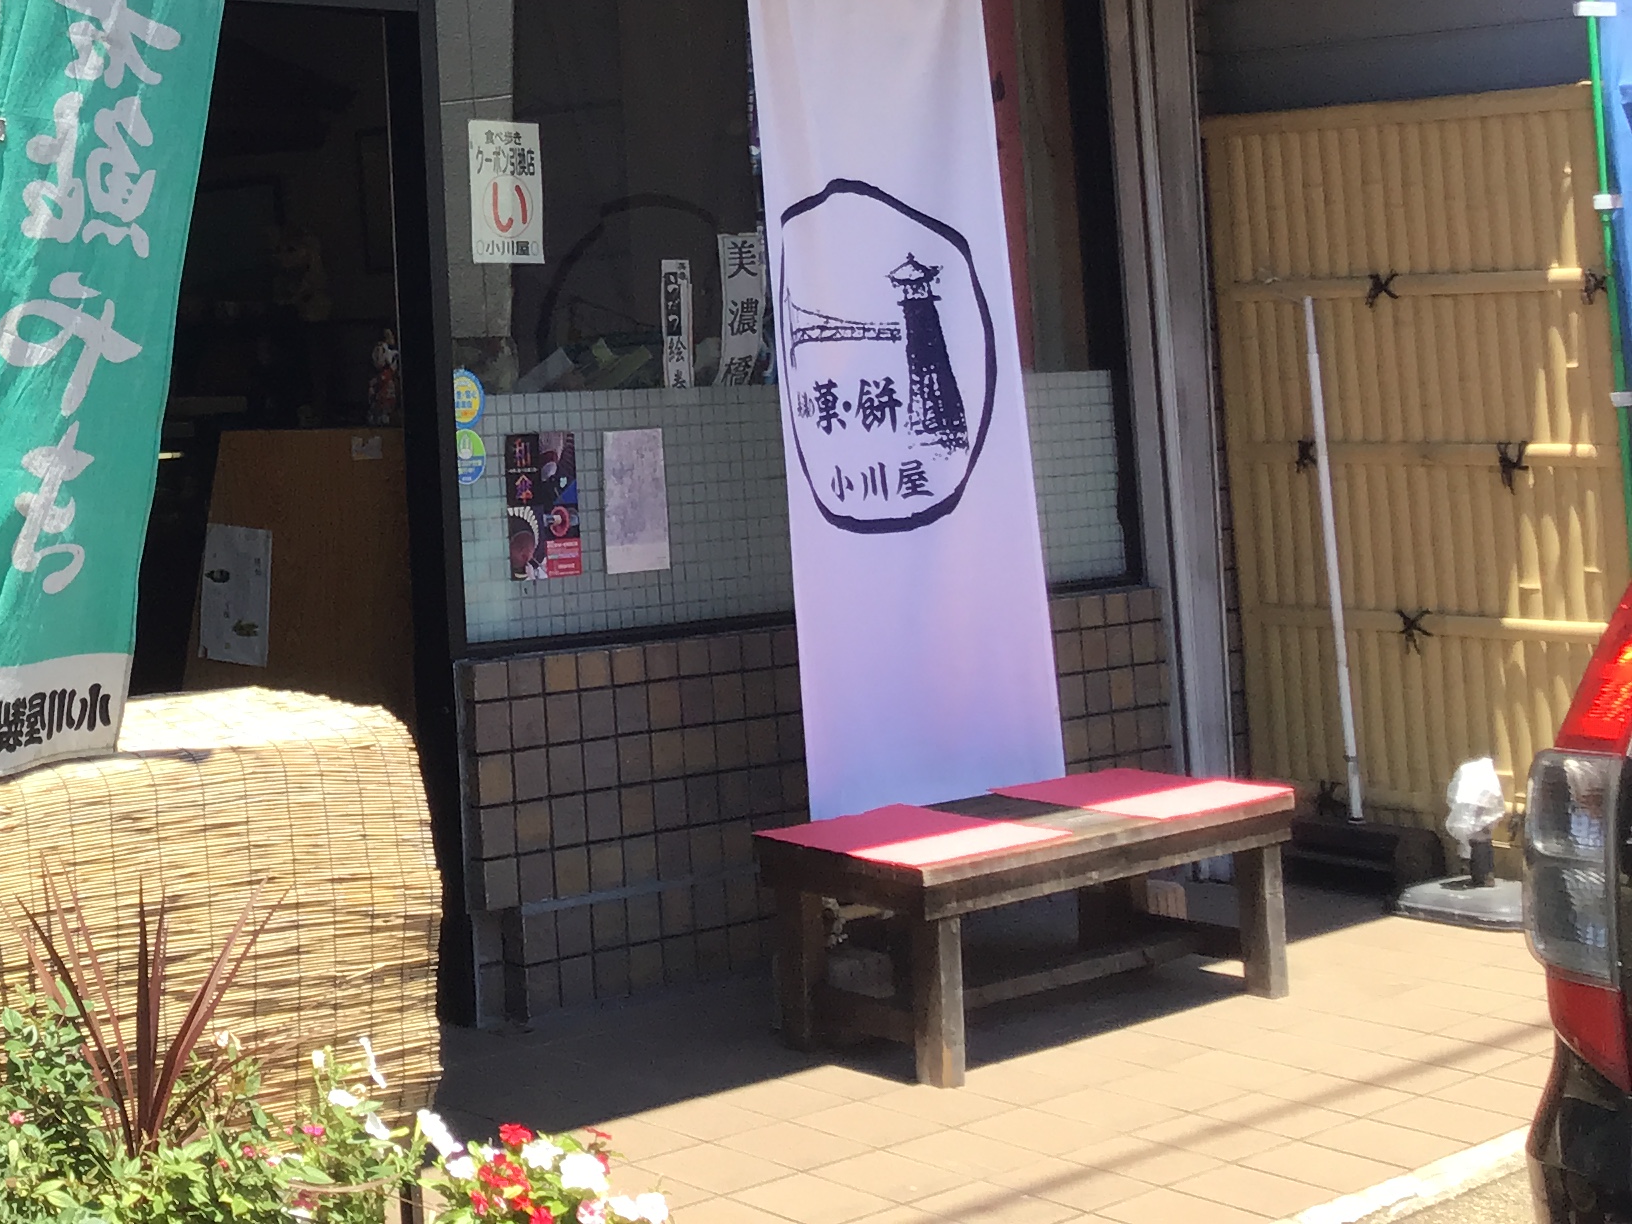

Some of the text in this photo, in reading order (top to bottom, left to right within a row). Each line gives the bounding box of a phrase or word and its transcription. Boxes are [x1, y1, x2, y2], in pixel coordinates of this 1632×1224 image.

[484, 129, 523, 146] 食べ歩き
[475, 145, 536, 176] クーポン引換店
[492, 181, 528, 233] い
[830, 459, 935, 503] 小川屋
